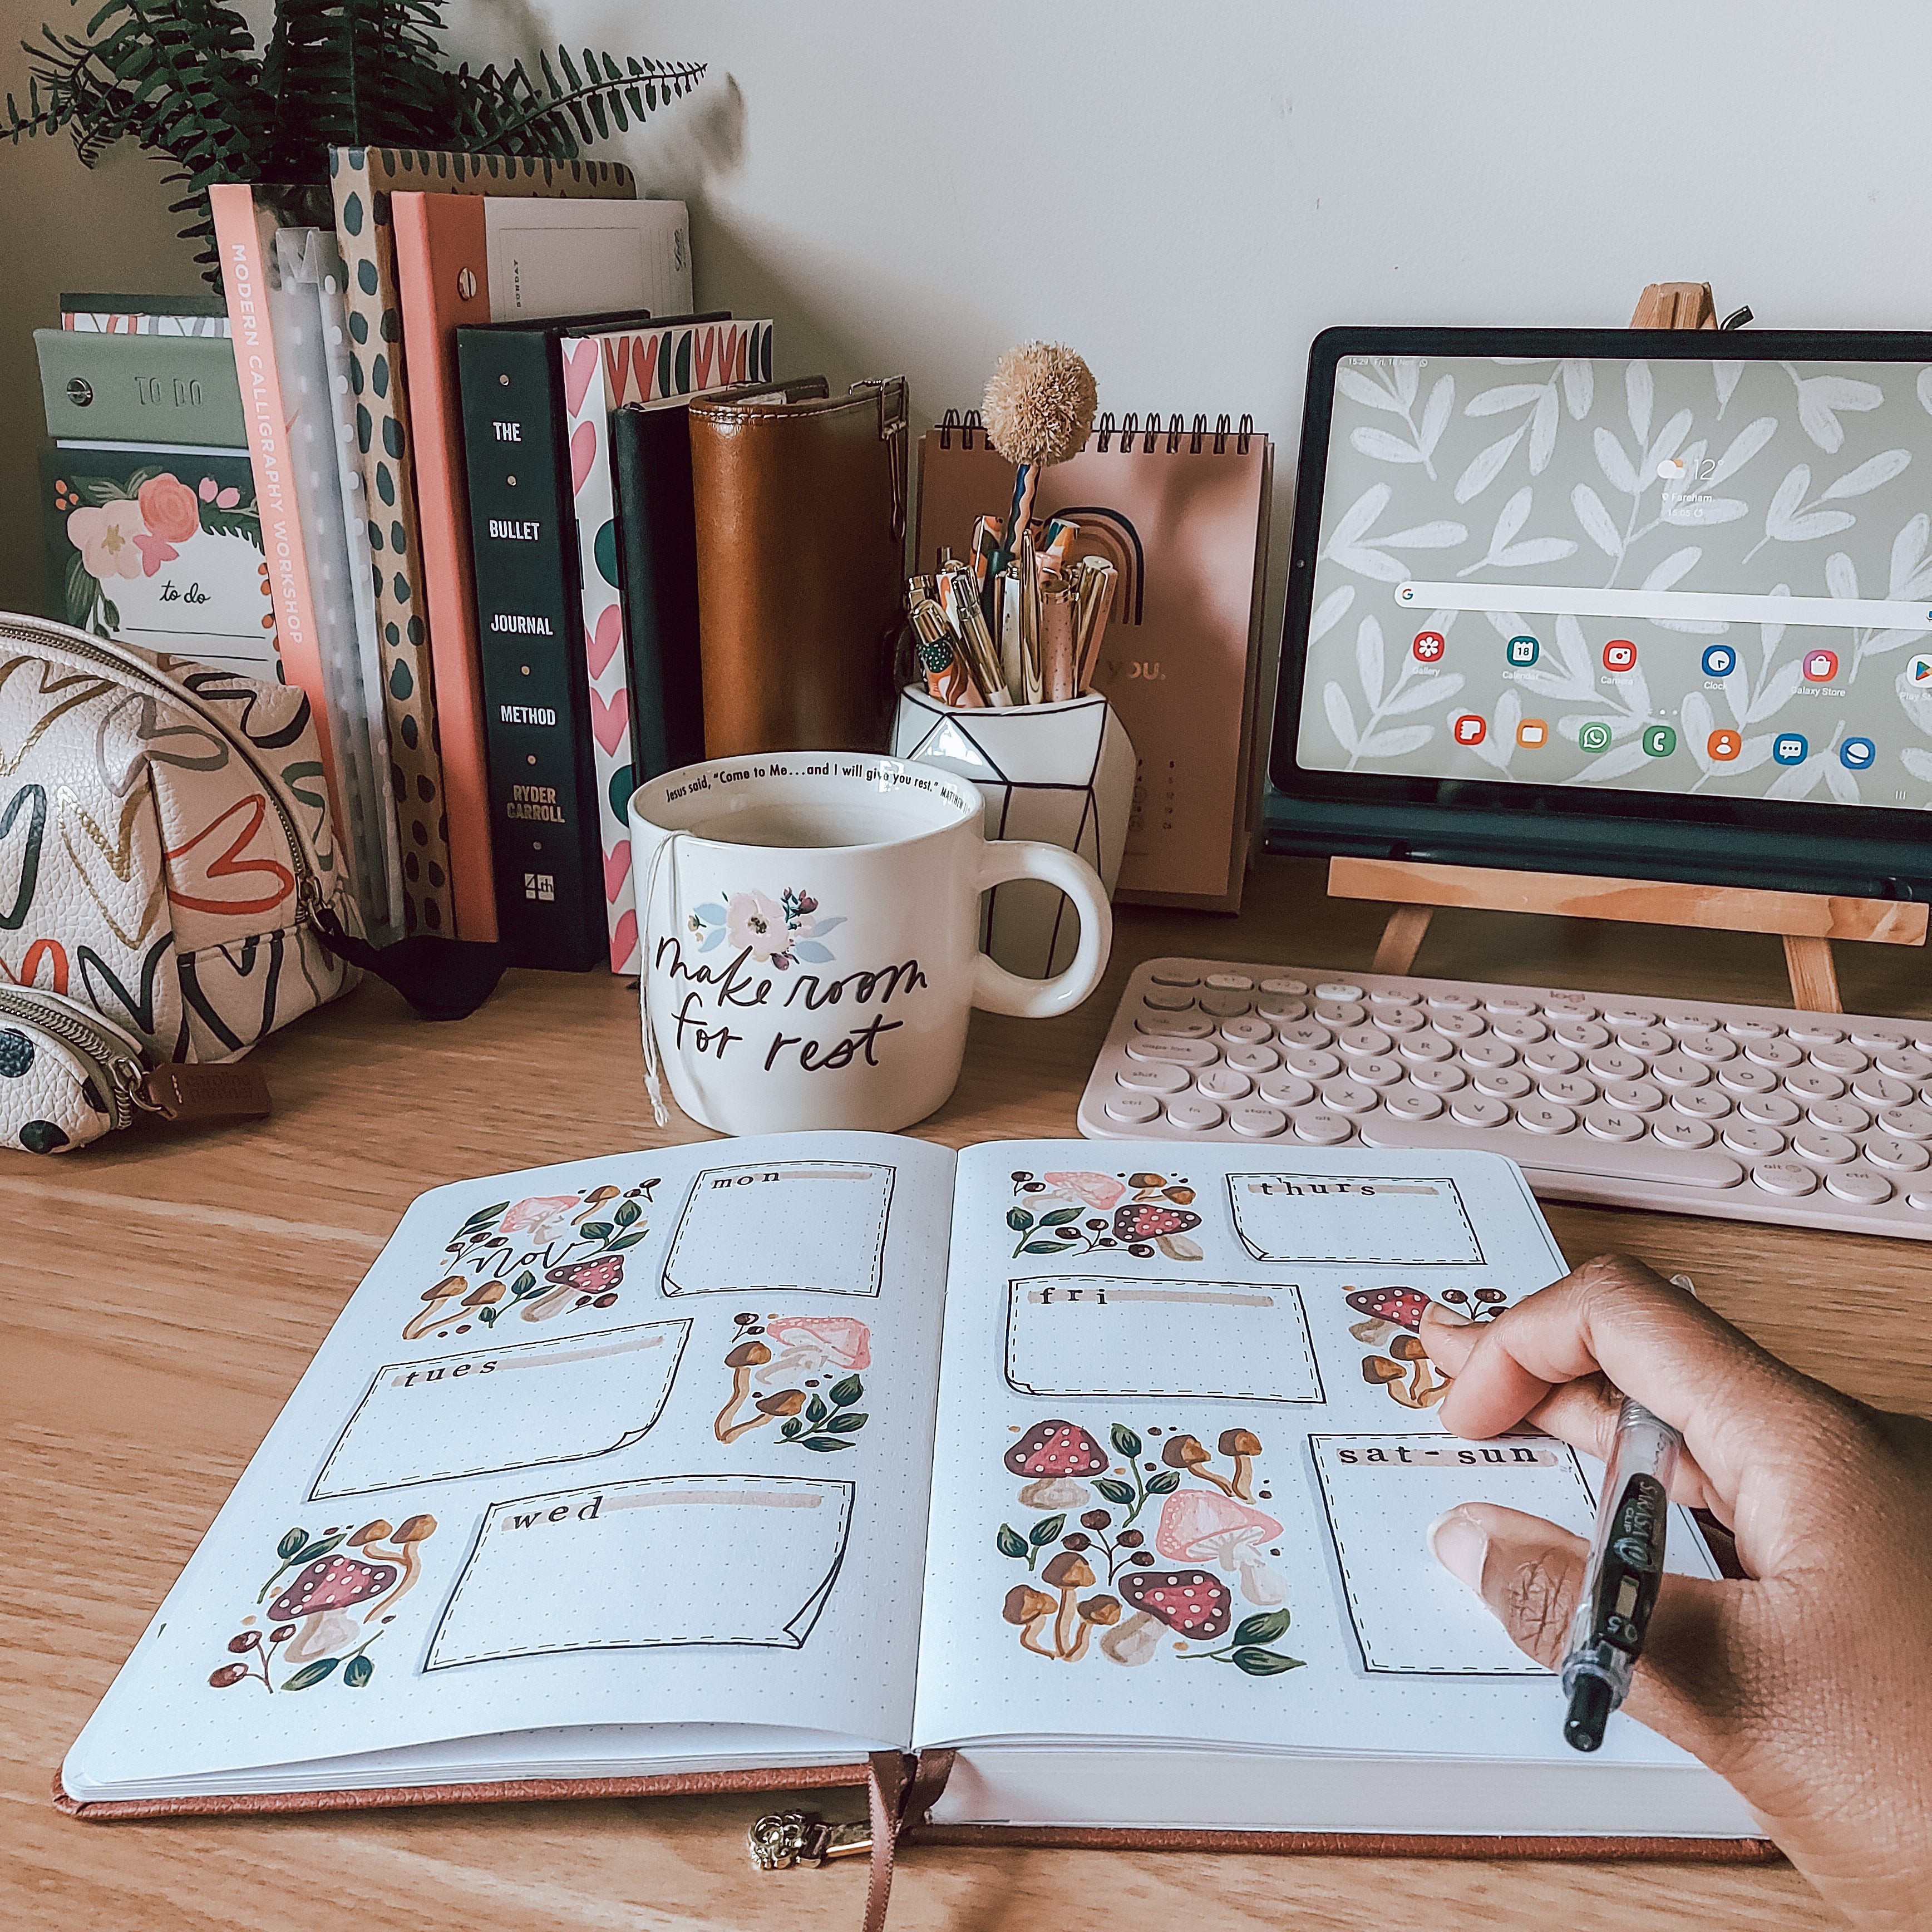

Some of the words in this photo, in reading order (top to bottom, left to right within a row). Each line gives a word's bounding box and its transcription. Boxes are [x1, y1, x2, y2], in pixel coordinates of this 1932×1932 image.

[135, 377, 161, 405] TO
[173, 378, 202, 407] DO
[493, 422, 521, 441] THE
[231, 244, 259, 346] MODERN
[249, 355, 283, 512] CALLIGRAPHY
[272, 521, 303, 643] WORKSHOP
[1672, 493, 1712, 502] Fareham
[489, 520, 540, 540] BULLET
[159, 580, 181, 601] to
[184, 583, 211, 604] do
[491, 614, 554, 636] JOURNAL
[1517, 647, 1529, 656] 18
[1413, 667, 1440, 677] Gallery
[1502, 671, 1539, 680] Calendar
[1600, 676, 1633, 685] Camera
[1704, 682, 1727, 690] Clock
[1791, 686, 1820, 697] Galaxy
[1822, 688, 1846, 697] Store
[1899, 692, 1919, 702] Play
[500, 705, 556, 726] METHOD
[514, 785, 556, 804] RYDER
[666, 786, 687, 803] Jesus
[688, 775, 711, 793] said,
[753, 767, 766, 778] to
[834, 763, 837, 775] I
[842, 764, 862, 777] will
[893, 773, 911, 785] you
[940, 787, 964, 810] MATTHEW
[507, 802, 565, 823] CARROLL
[655, 936, 772, 1007] make
[784, 959, 928, 1011] room
[671, 992, 743, 1059] for
[765, 1014, 904, 1071] rest
[1344, 1091, 1354, 1099] X
[1608, 1118, 1621, 1127] N
[1676, 1125, 1690, 1133] M
[711, 1172, 780, 1189] mon
[1260, 1178, 1376, 1196] thurs
[1039, 1287, 1108, 1304] fri
[405, 1361, 498, 1387] tues
[513, 1495, 603, 1529] wed
[1632, 1481, 1657, 1537] SARASA
[1623, 1507, 1634, 1533] CLIP
